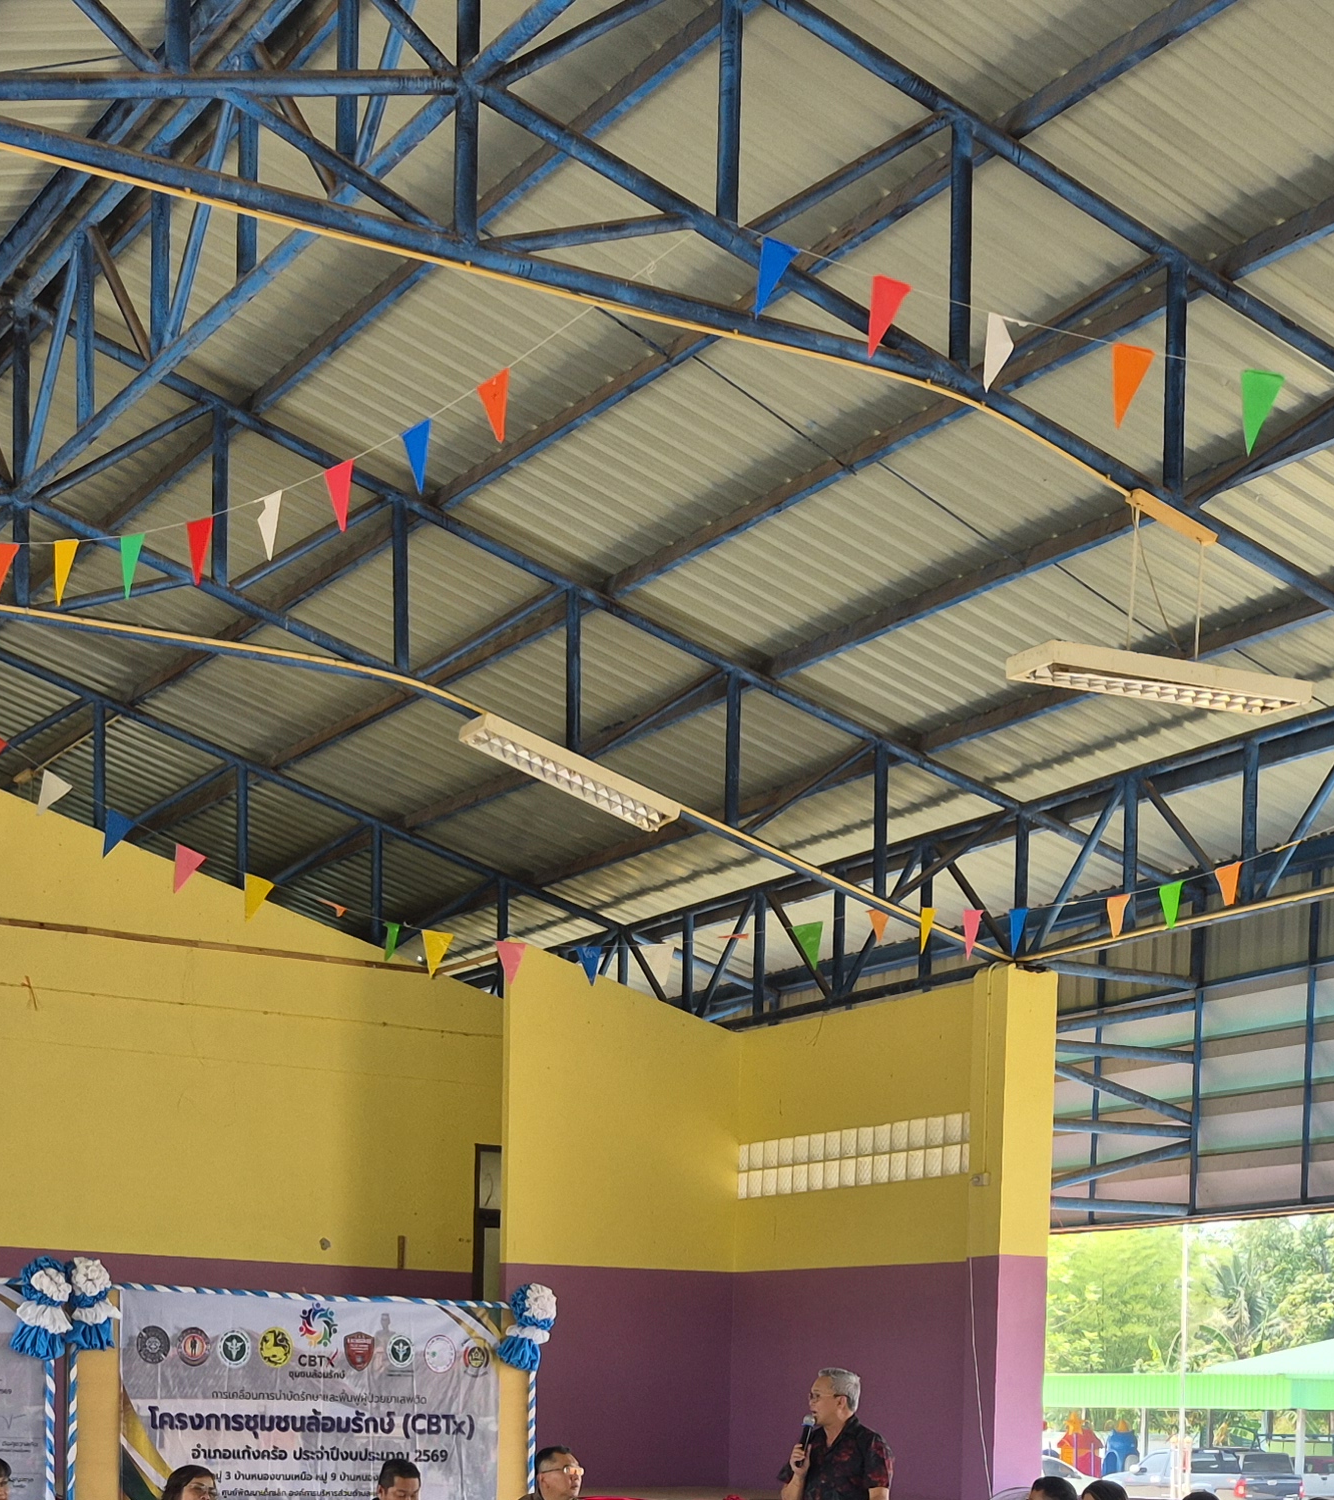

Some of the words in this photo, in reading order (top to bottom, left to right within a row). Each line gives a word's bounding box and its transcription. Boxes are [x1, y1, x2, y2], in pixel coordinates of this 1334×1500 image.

[288, 1369, 346, 1380] ชุมชนล้อมรักษ์
[148, 1406, 396, 1439] โครงการชุมชนล้อมรักษ์
[402, 1412, 475, 1440] (CBTx)
[191, 1446, 288, 1461] อำเภอแก้งคร้อ
[414, 1448, 449, 1463] 2569
[225, 1472, 232, 1481] 3
[234, 1471, 313, 1482] บ้านหนองขามเหนือ
[331, 1472, 337, 1482] 9
[340, 1471, 379, 1483] บ้านหนอง
[288, 1488, 378, 1498] องค์การบริหารส่วนตำบล
